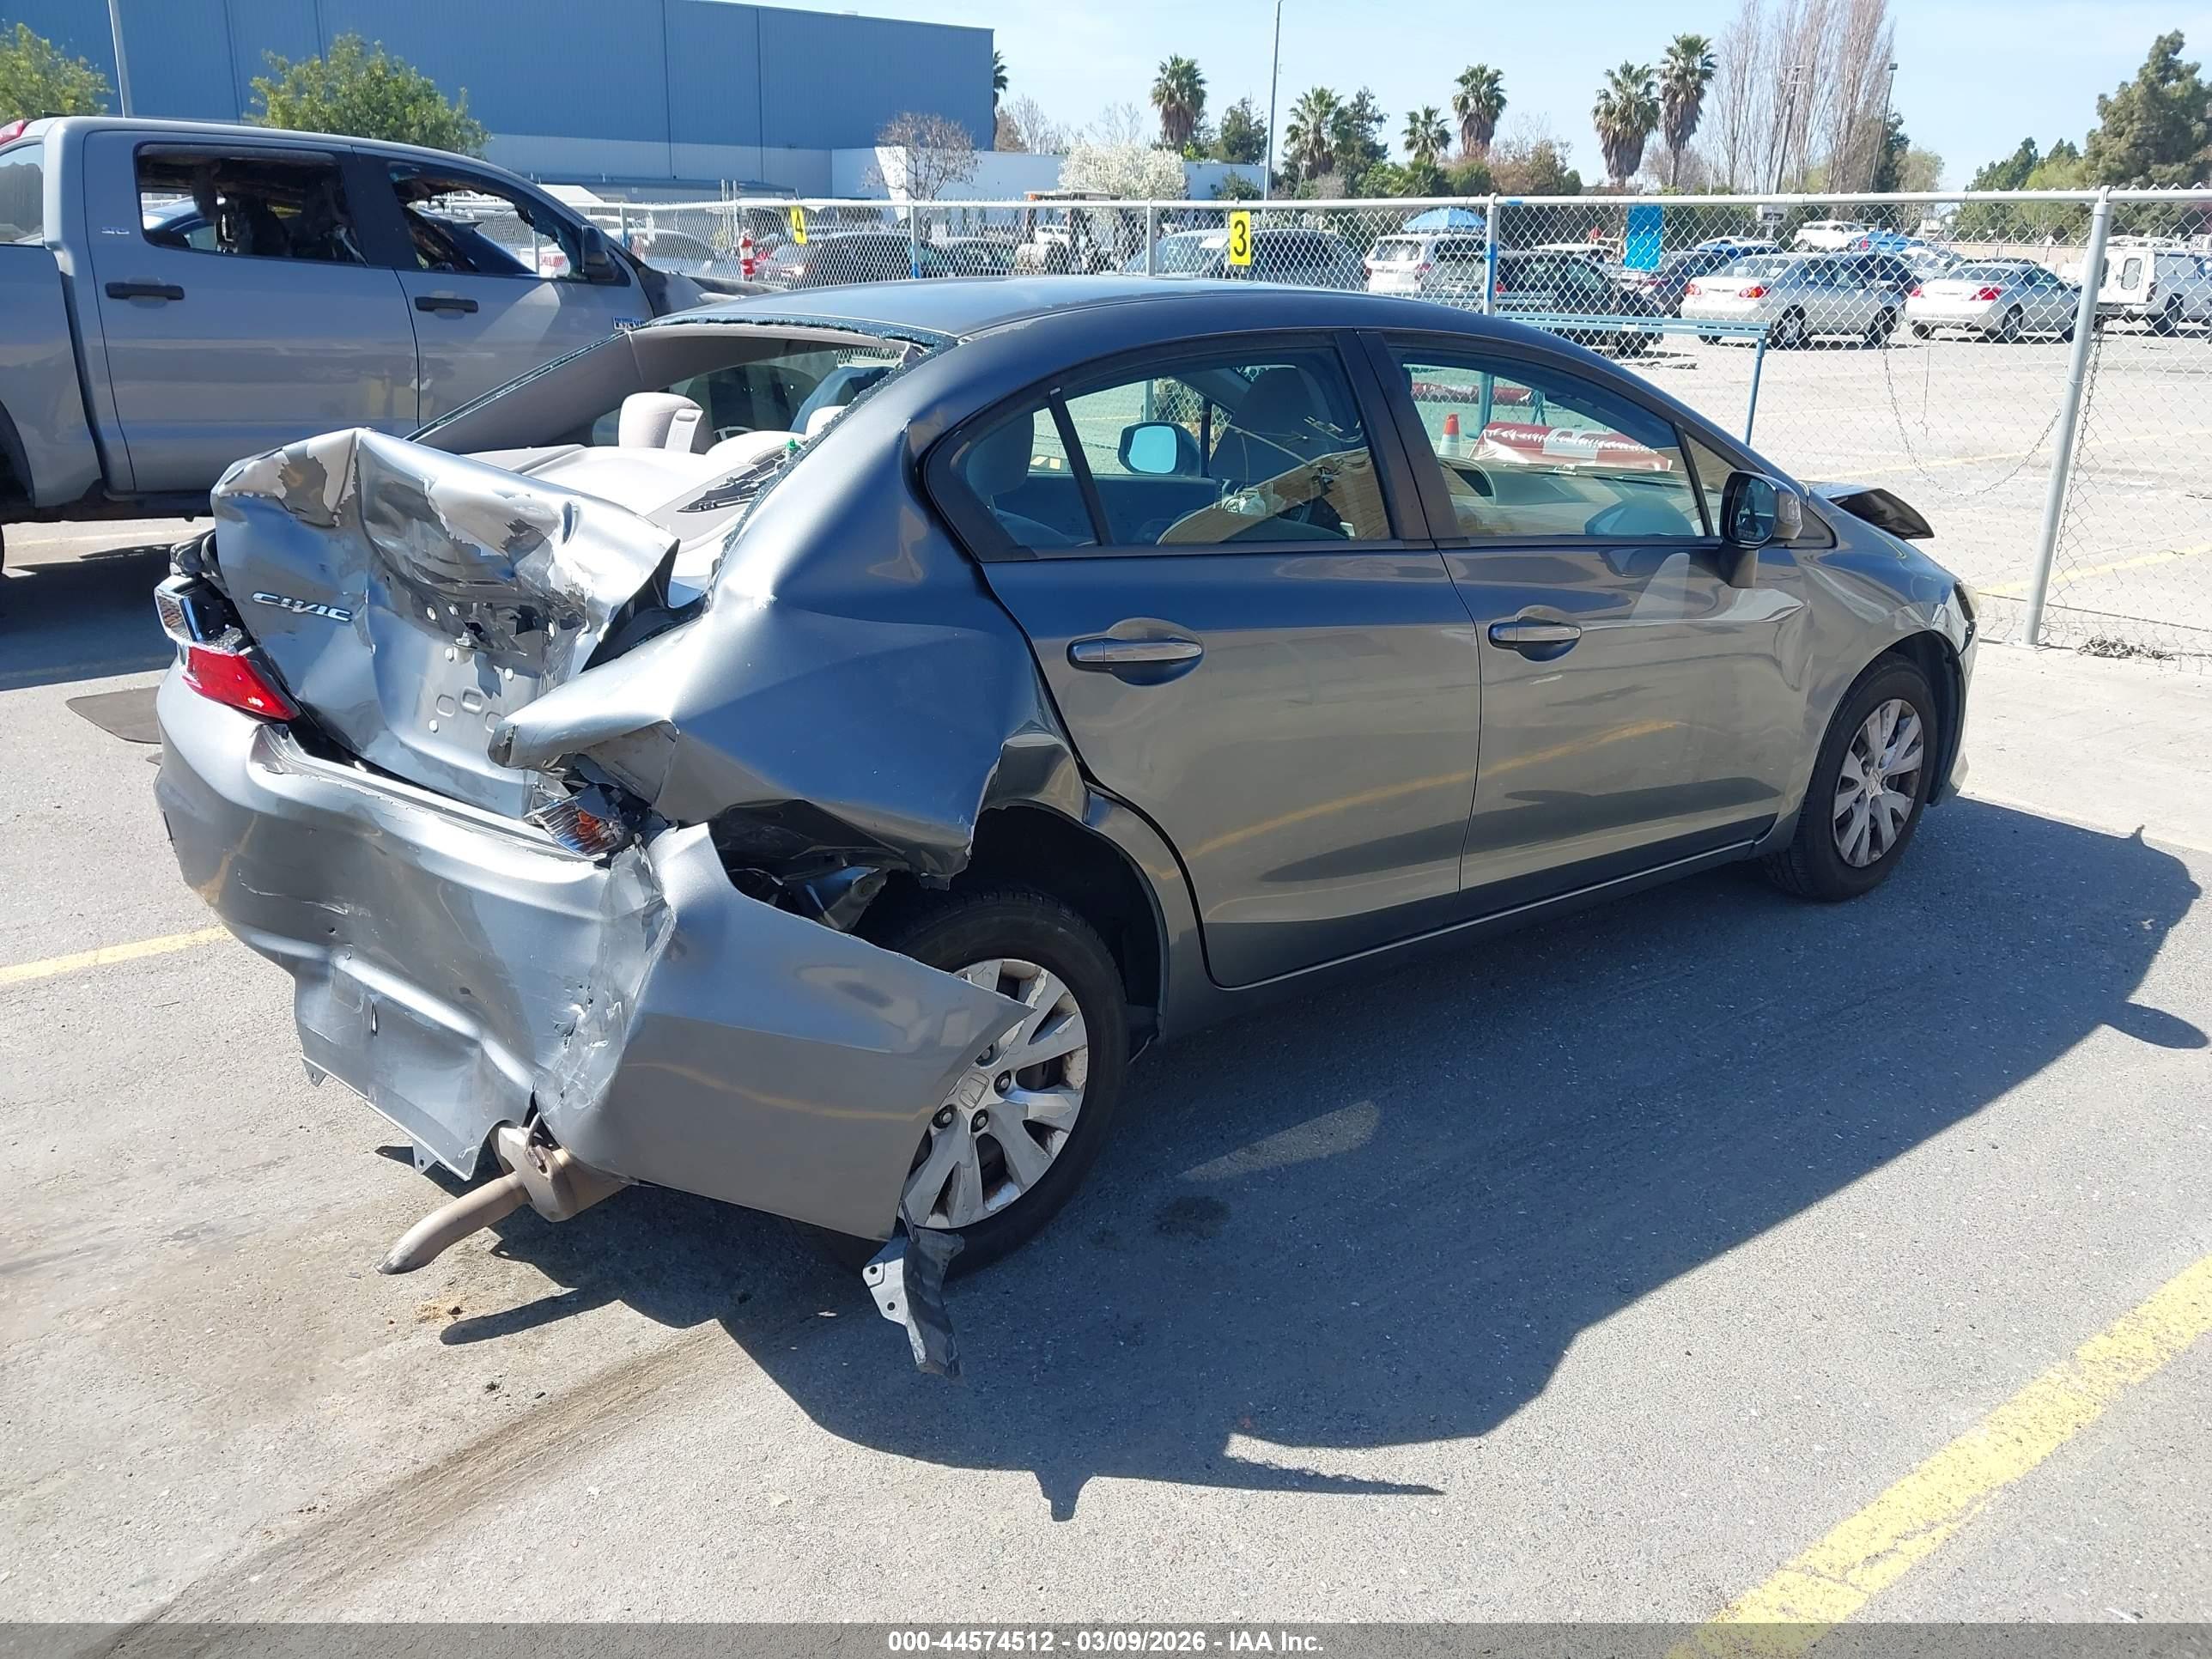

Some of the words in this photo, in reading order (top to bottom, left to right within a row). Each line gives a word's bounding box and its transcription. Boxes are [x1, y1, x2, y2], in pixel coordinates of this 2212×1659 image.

[795, 210, 804, 238] 4
[1234, 220, 1247, 257] 3
[252, 592, 351, 622] CIVIC
